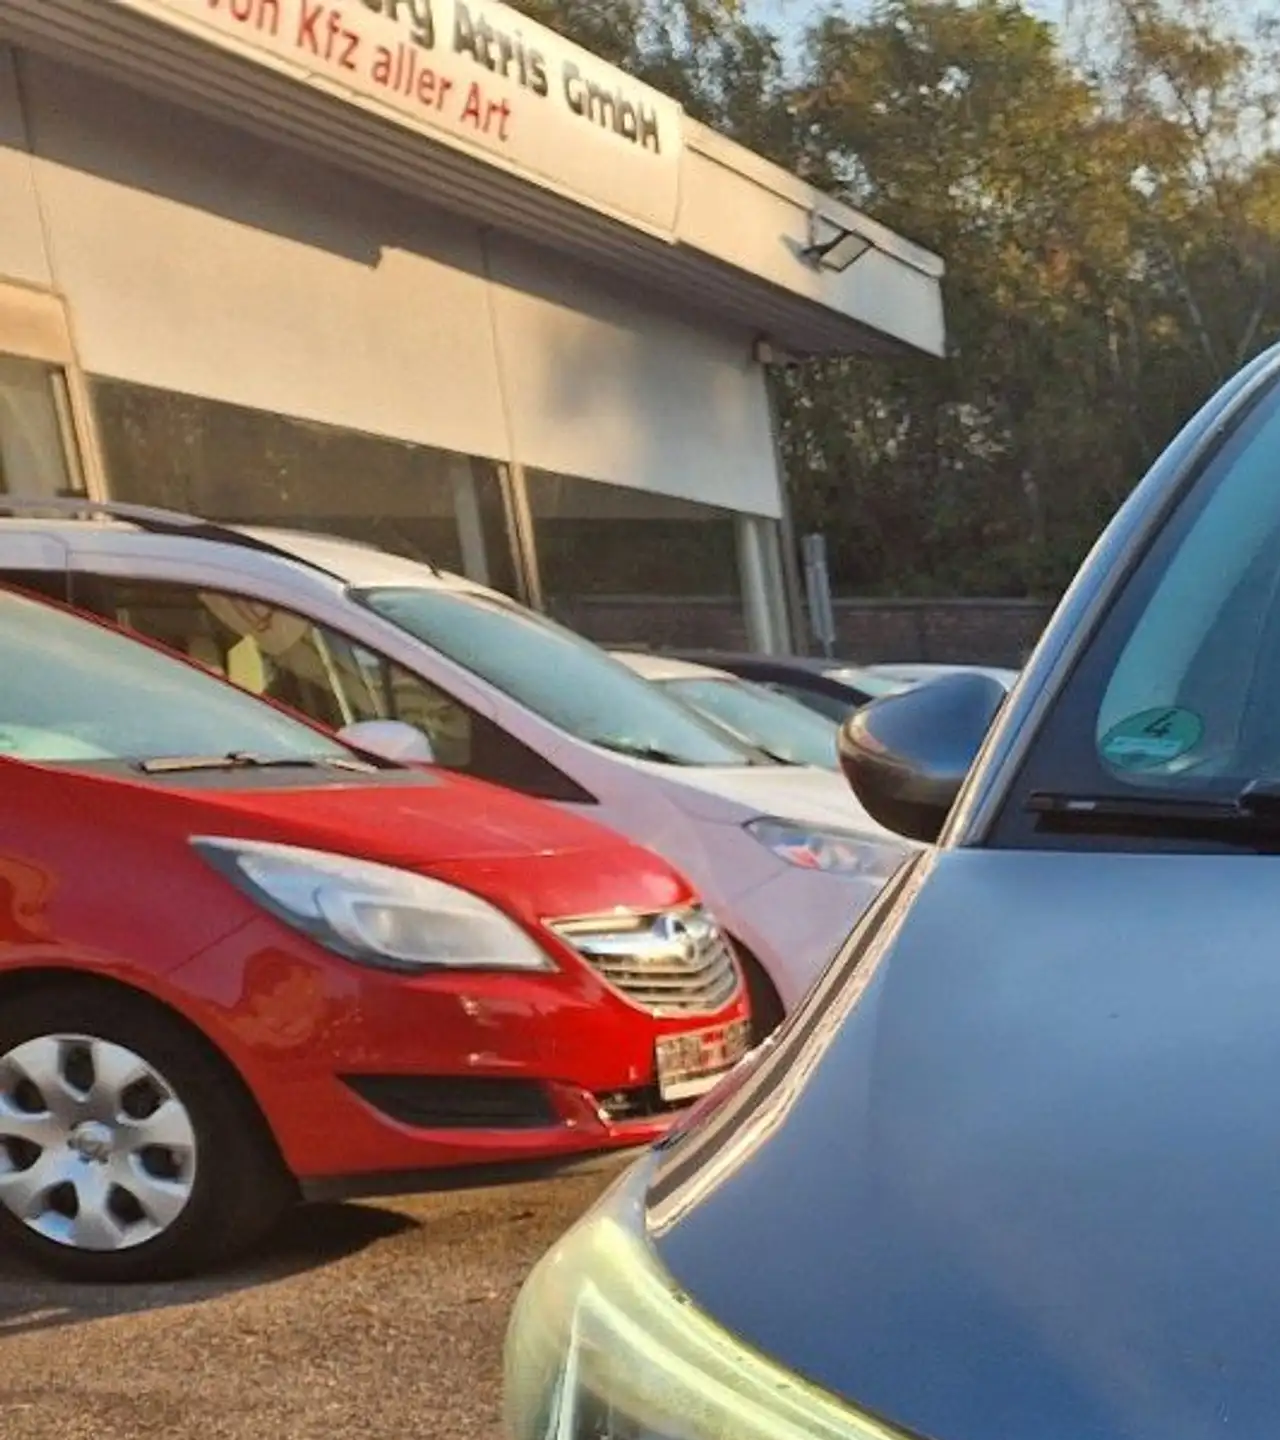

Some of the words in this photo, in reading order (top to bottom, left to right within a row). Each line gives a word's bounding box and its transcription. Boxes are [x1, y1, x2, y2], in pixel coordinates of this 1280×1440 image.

[296, 0, 360, 71] Kfz
[370, 42, 453, 111] aller
[459, 80, 511, 142] Art
[453, 1, 549, 97] Atris
[562, 59, 661, 155] GmbH
